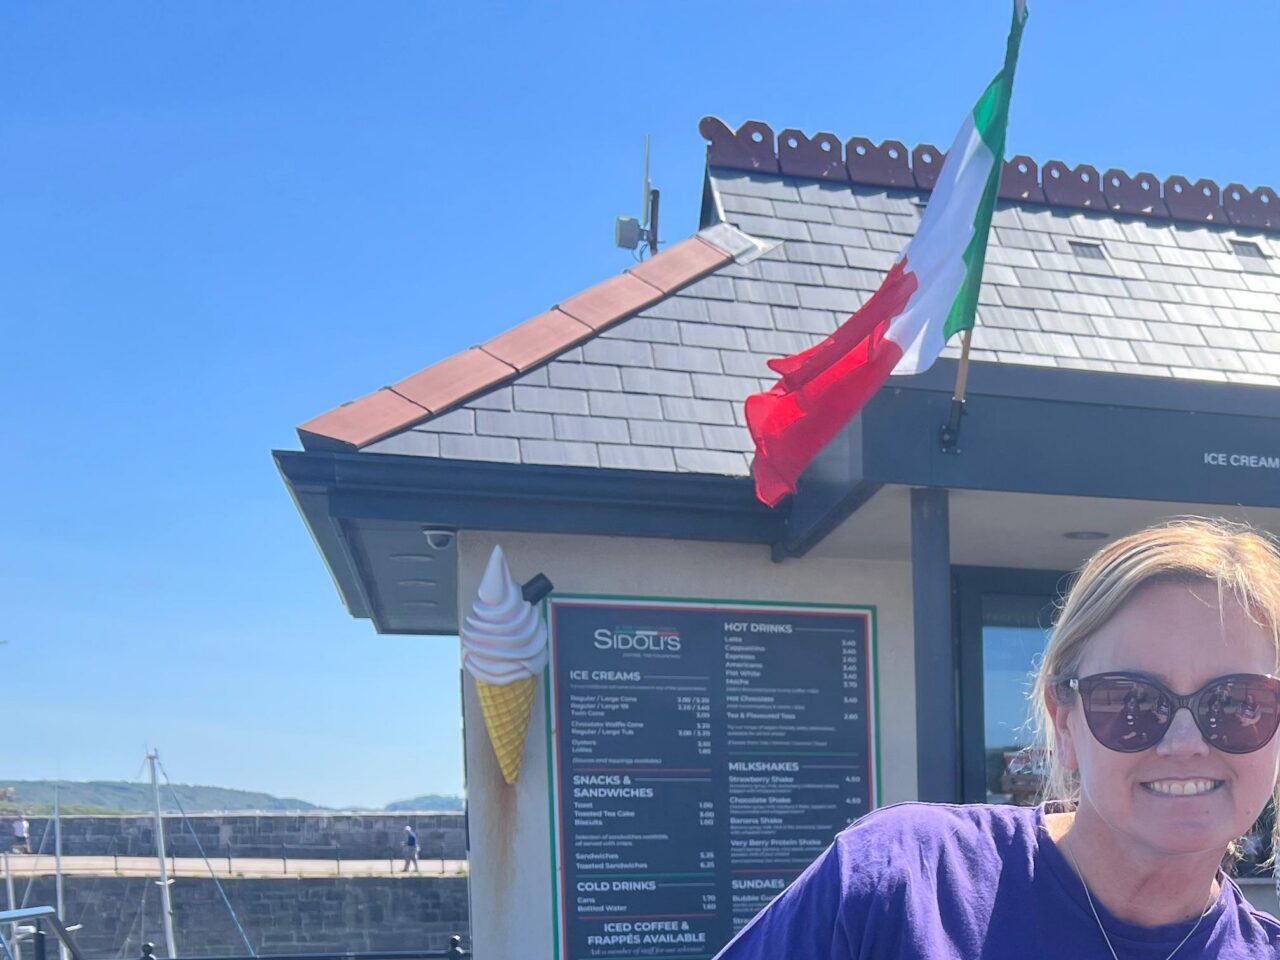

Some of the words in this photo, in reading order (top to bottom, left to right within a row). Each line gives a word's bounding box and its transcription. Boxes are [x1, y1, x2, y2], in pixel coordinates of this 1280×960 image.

[1204, 453, 1227, 466] ICE
[1229, 454, 1280, 469] CREAM
[724, 622, 748, 632] HOT
[750, 623, 793, 634] DRINKS
[594, 628, 681, 651] SIDOLI'S
[570, 670, 589, 681] ICE
[591, 671, 641, 681] CREAMS
[728, 762, 799, 771] MILKSHAKES
[573, 775, 621, 785] SNACKS
[622, 775, 631, 785] &
[729, 776, 770, 784] Strawberry
[573, 788, 654, 798] SANDWICHES
[730, 839, 748, 847] Very
[749, 839, 769, 847] Berry
[577, 882, 610, 891] COLD
[612, 881, 656, 891] DRINKS
[732, 879, 785, 889] SUNDAES
[604, 922, 632, 933] ICED
[634, 921, 679, 932] COFFEE
[681, 921, 689, 930] &
[587, 933, 641, 945] FRAPPÉS
[643, 933, 706, 944] AVAILABLE
